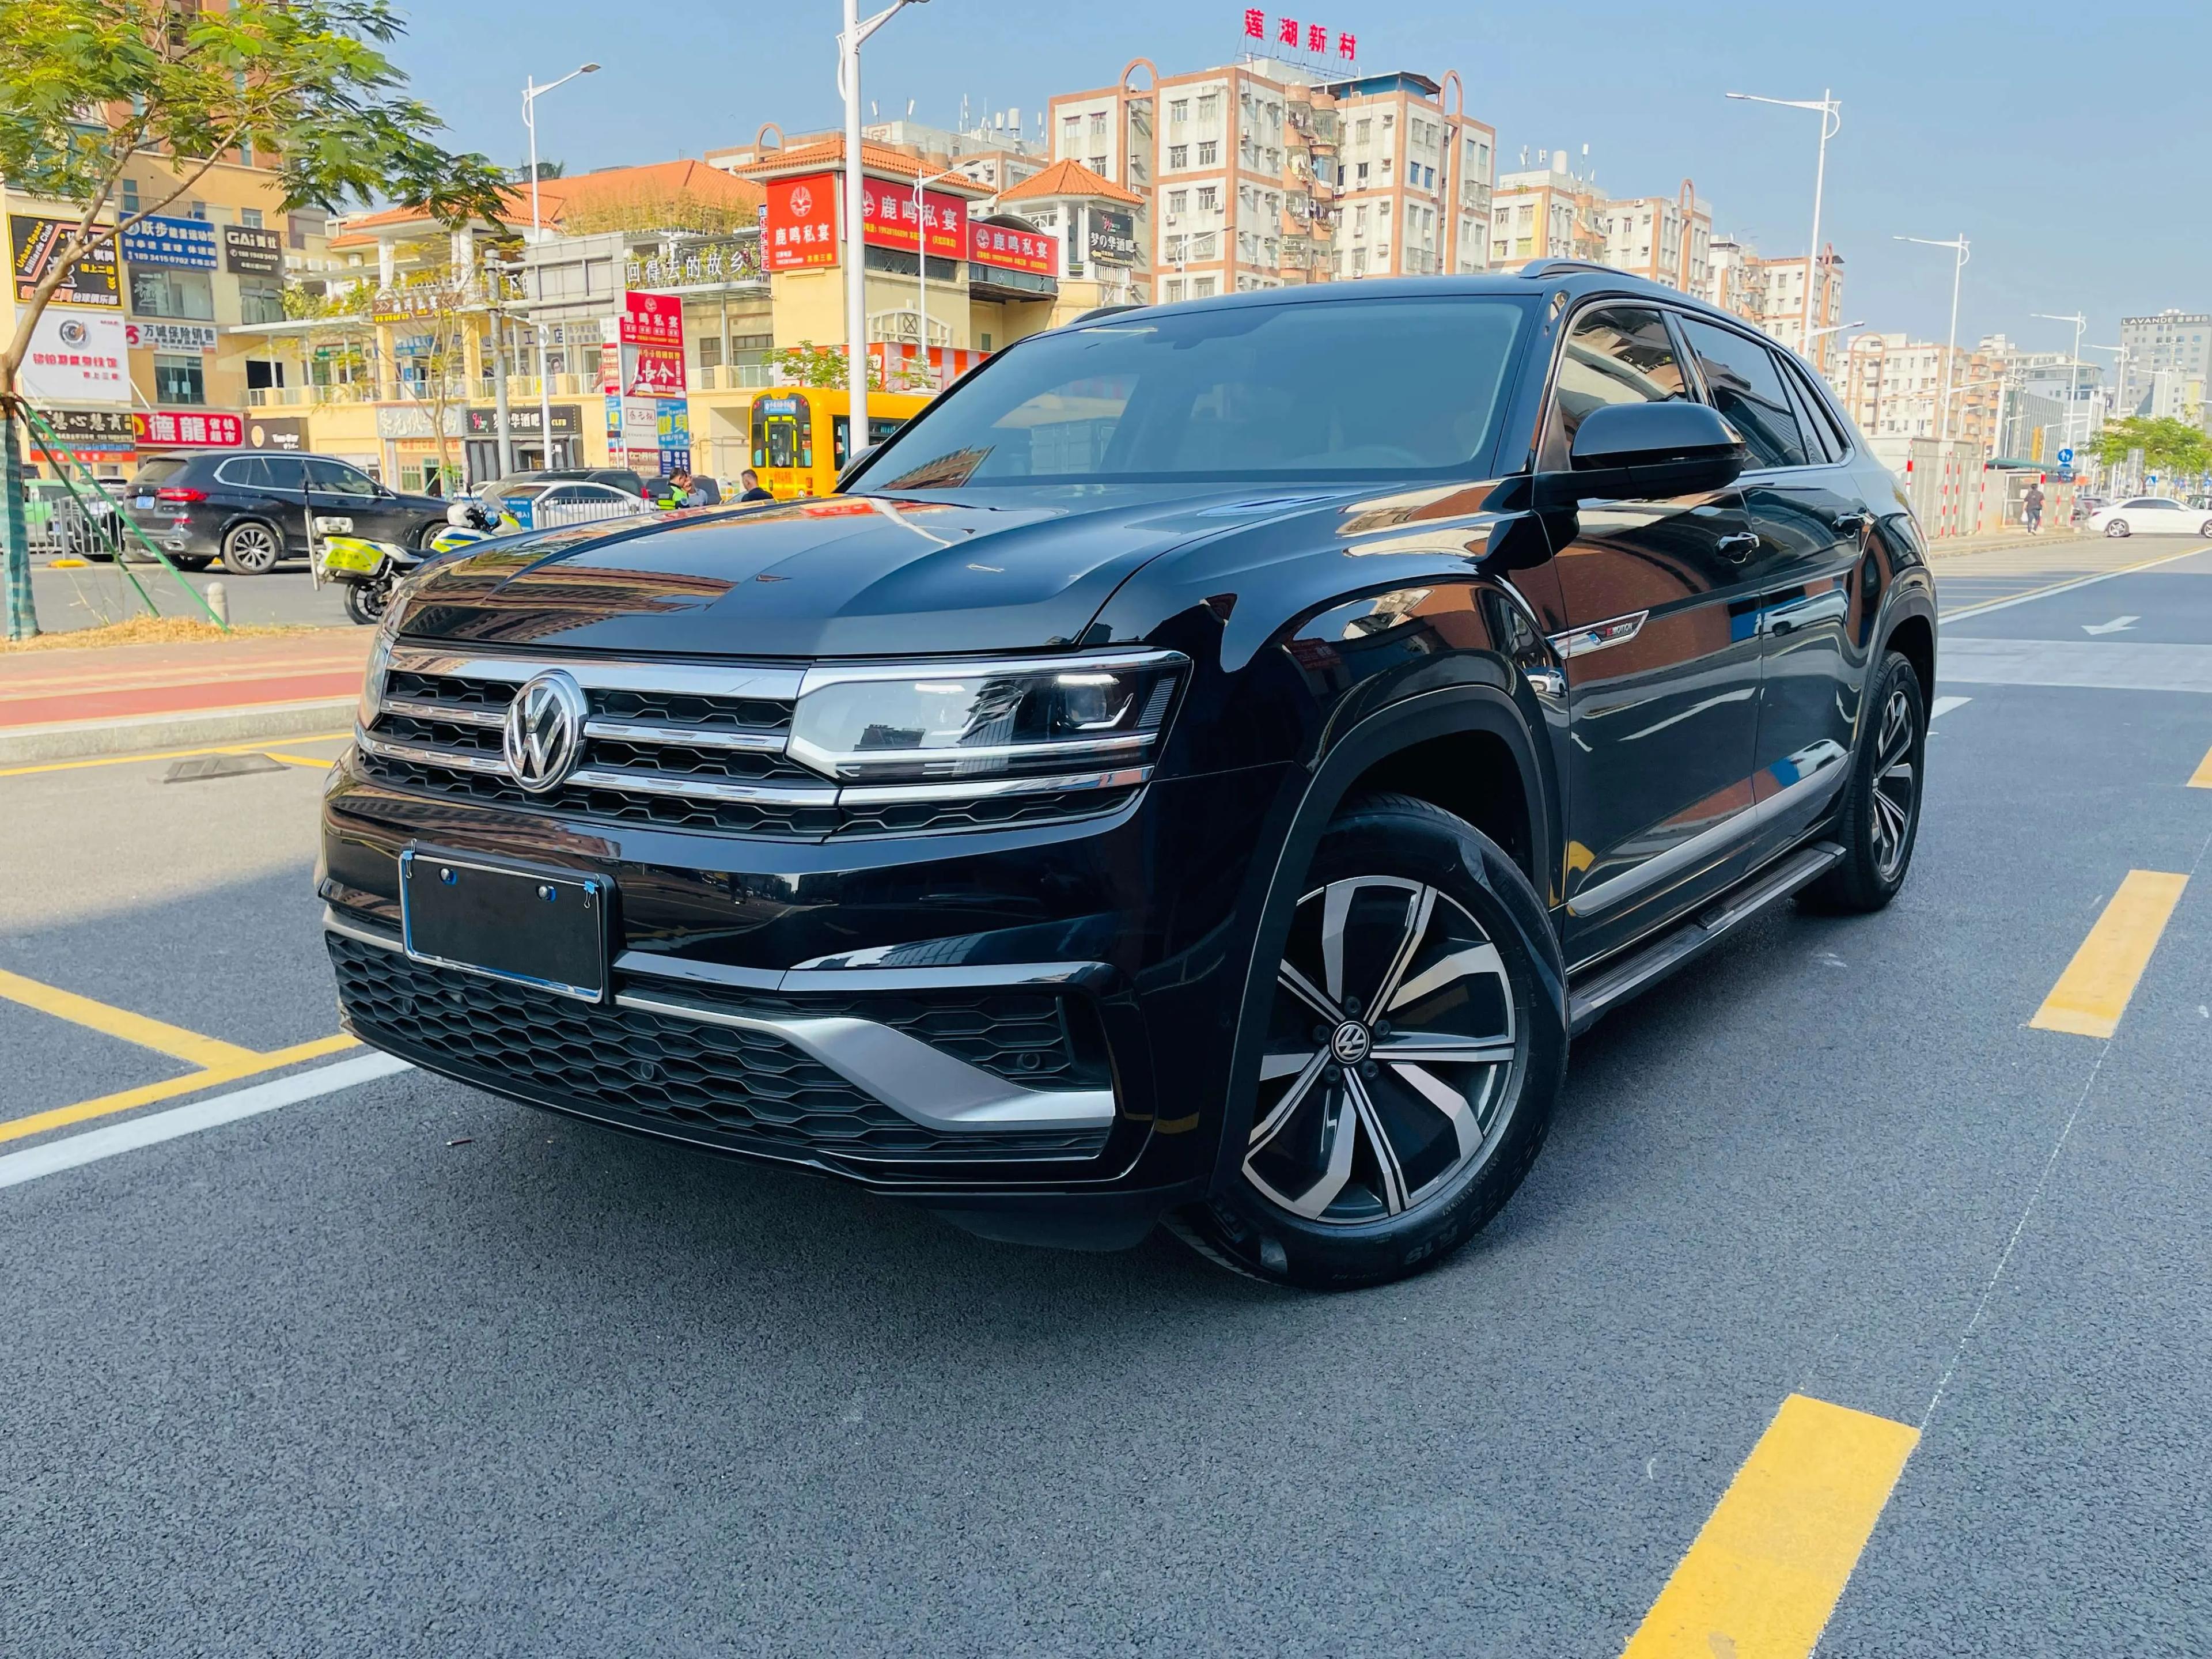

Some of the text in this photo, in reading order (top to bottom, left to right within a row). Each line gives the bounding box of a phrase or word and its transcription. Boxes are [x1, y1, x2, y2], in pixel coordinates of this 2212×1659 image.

[1245, 9, 1357, 60] 莲湖新村
[881, 195, 957, 232] 鹿鸣私宴
[16, 221, 44, 268] Urban Space
[40, 224, 53, 242] Club
[775, 223, 830, 246] 鹿鸣私宴
[993, 232, 1048, 259] 鹿鸣私宴
[551, 418, 567, 426] CLUB
